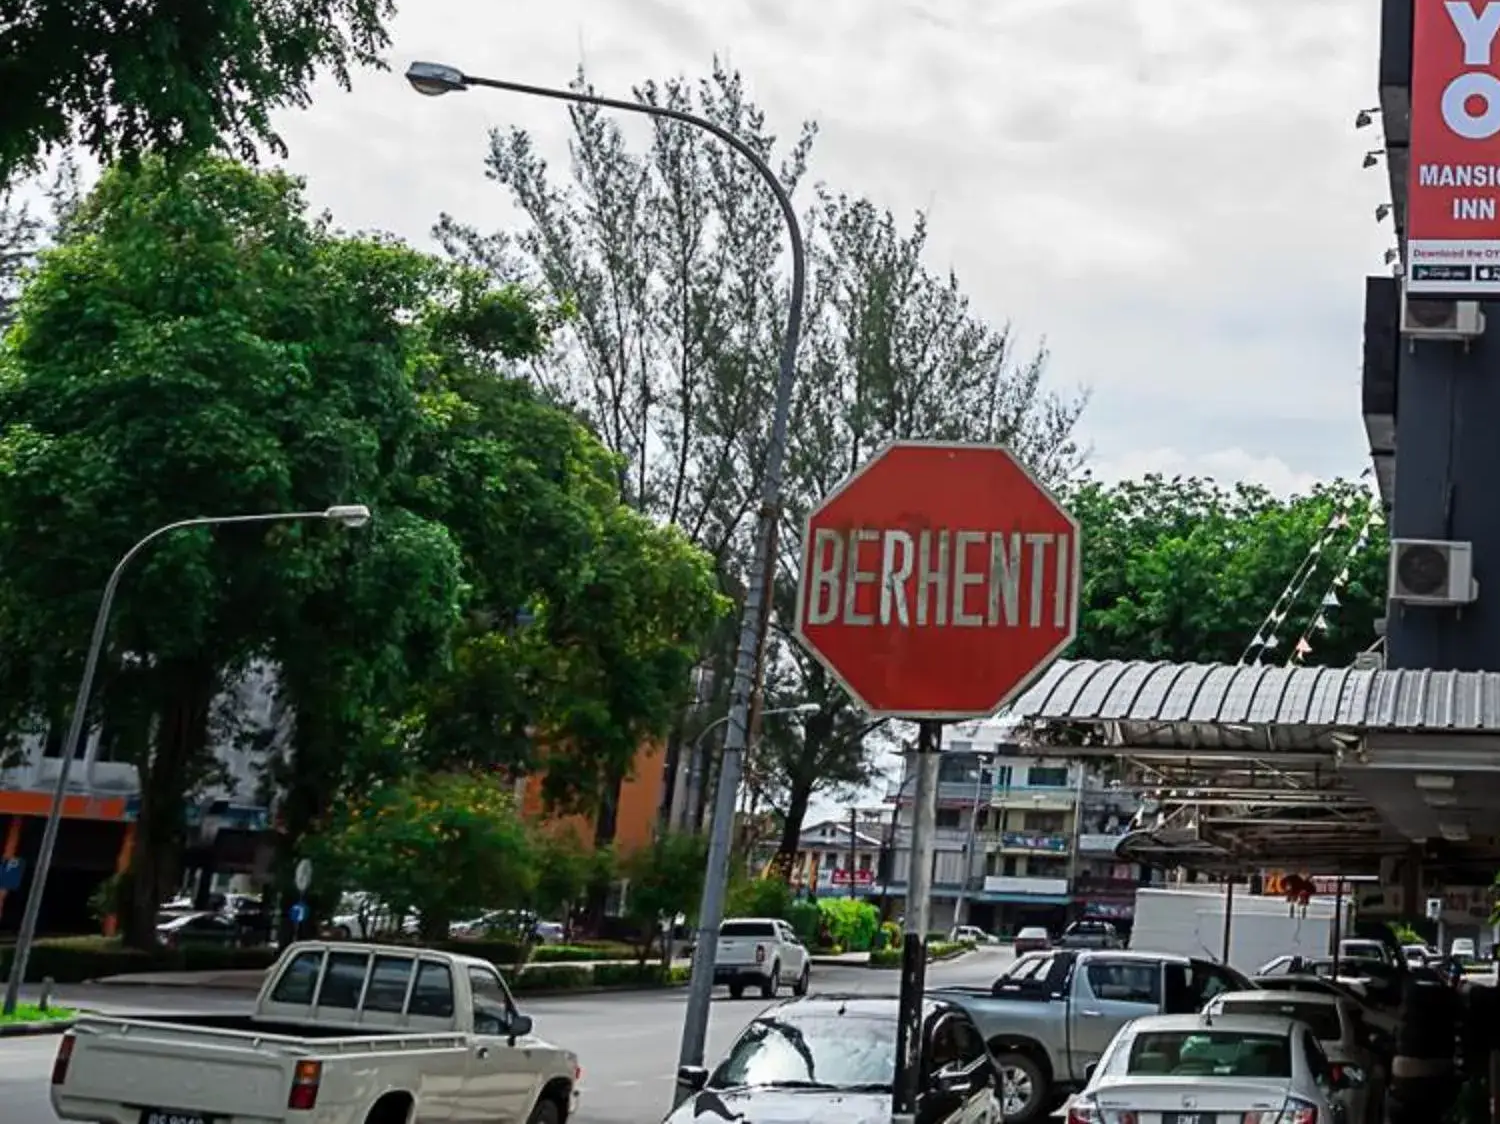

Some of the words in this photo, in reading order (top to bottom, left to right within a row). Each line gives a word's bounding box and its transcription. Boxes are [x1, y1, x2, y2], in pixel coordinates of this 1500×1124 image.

[1453, 197, 1496, 220] INN
[1413, 248, 1464, 258] Download
[1466, 249, 1482, 258] the
[808, 528, 1069, 627] BERHENTI
